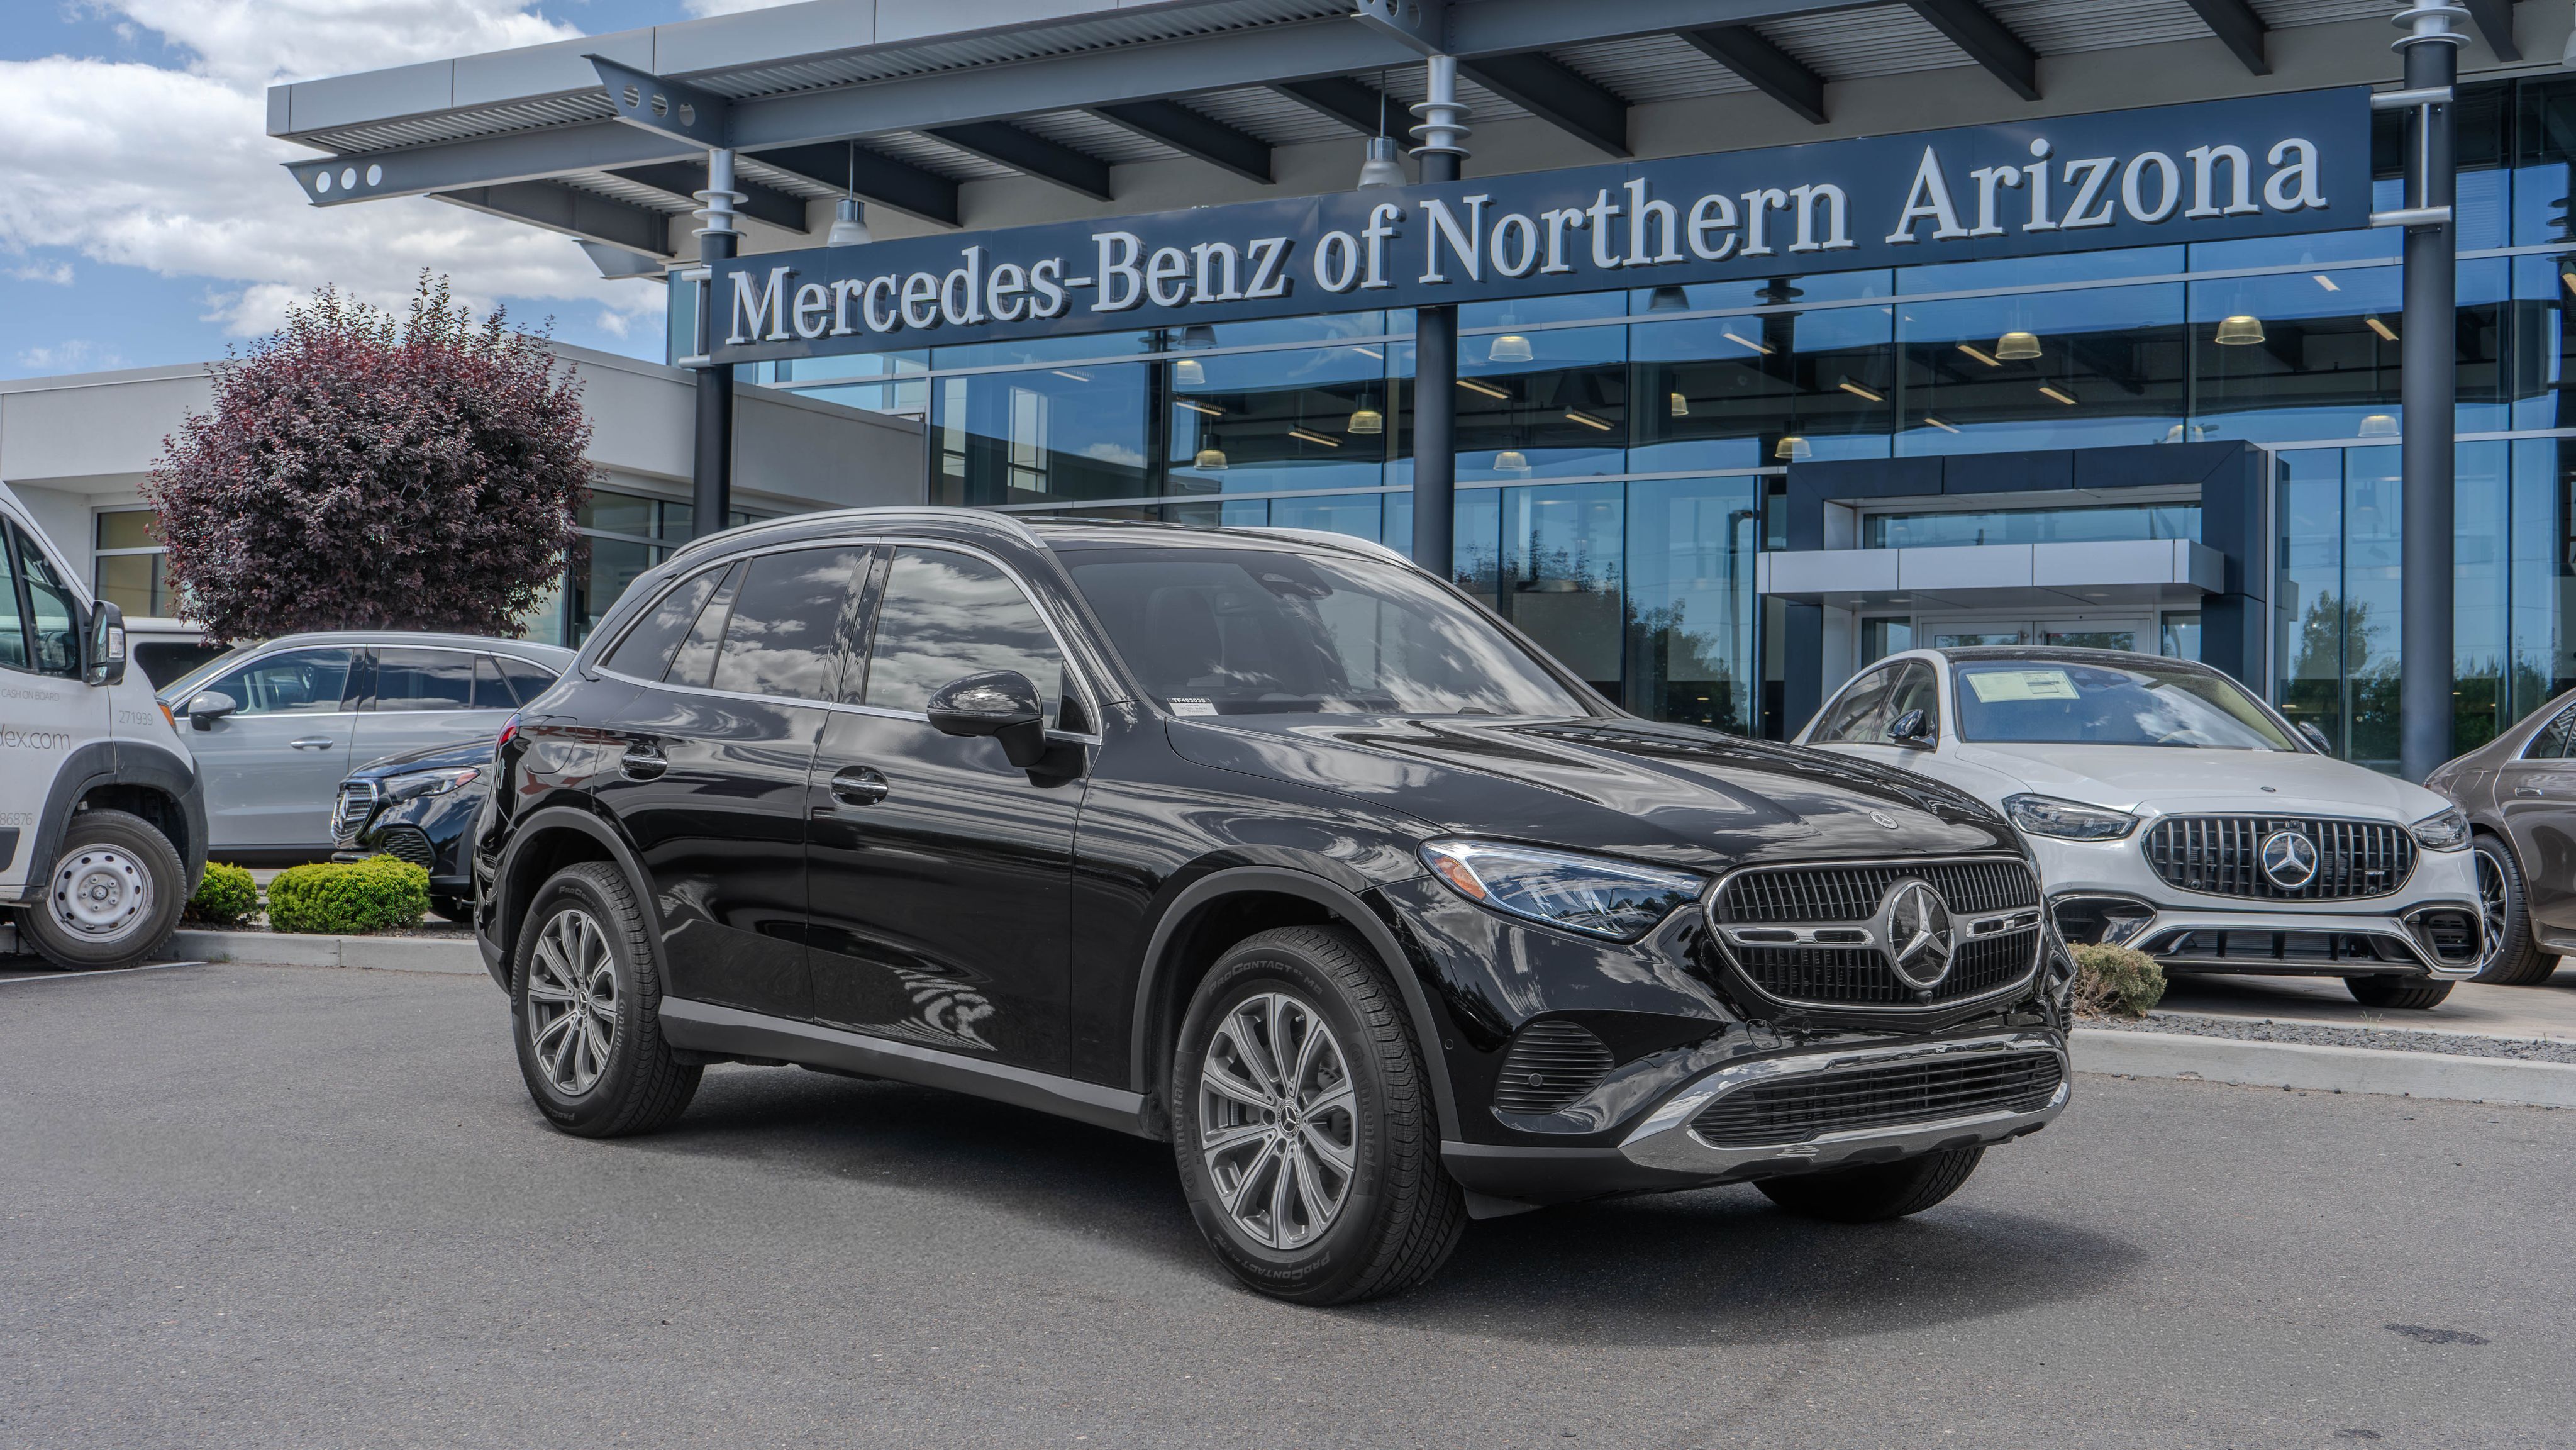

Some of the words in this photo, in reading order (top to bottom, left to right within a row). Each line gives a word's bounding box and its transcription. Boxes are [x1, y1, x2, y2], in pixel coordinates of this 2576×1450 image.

[726, 231, 1293, 346] Mercedes-Benz
[1313, 203, 1406, 293] of
[1419, 176, 1859, 284] Northern
[1886, 138, 2331, 244] Arizona
[1, 689, 21, 698] CASH
[22, 690, 34, 699] ON
[35, 691, 60, 701] BOARD
[119, 710, 153, 725] 271939
[0, 812, 33, 825] 86876
